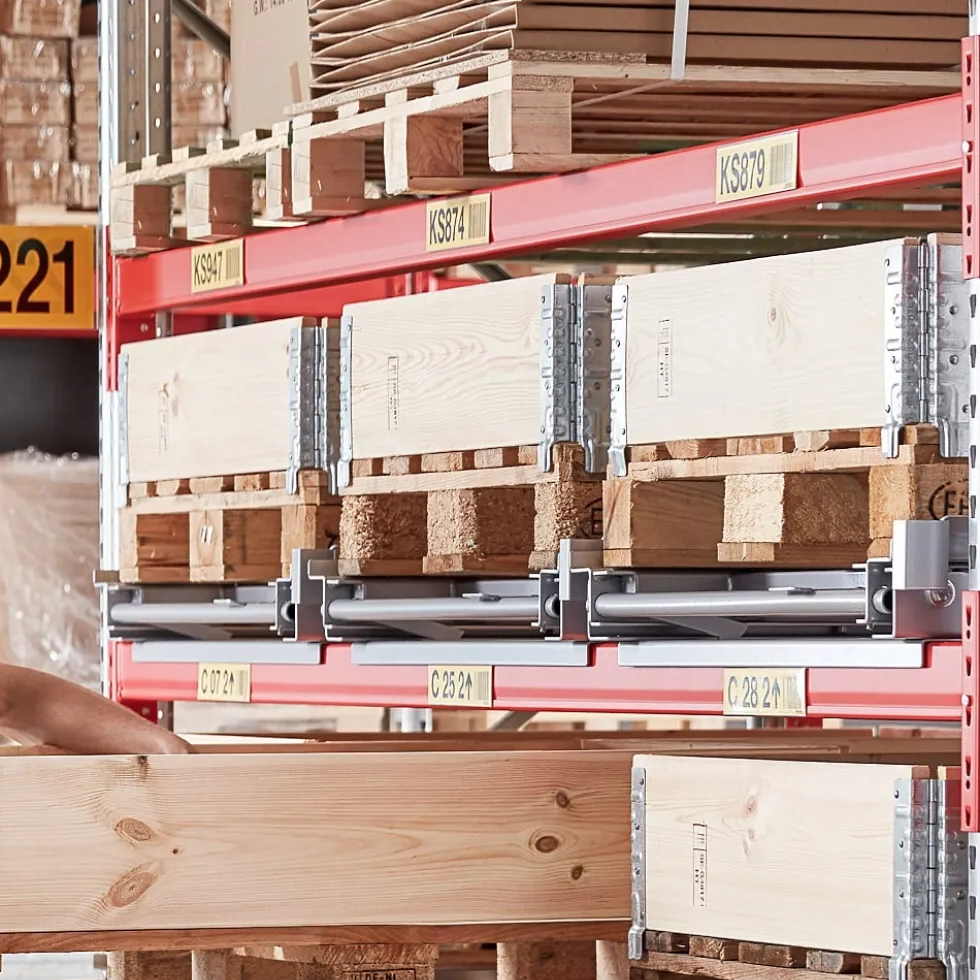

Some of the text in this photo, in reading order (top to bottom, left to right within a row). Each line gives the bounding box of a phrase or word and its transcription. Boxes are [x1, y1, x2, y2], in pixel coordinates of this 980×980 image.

[720, 148, 766, 195] KS879
[429, 205, 465, 245] KS874
[193, 250, 223, 287] KS947
[201, 669, 229, 695] C 07 2
[431, 669, 465, 699] C 25 2
[727, 675, 771, 708] C 28 2
